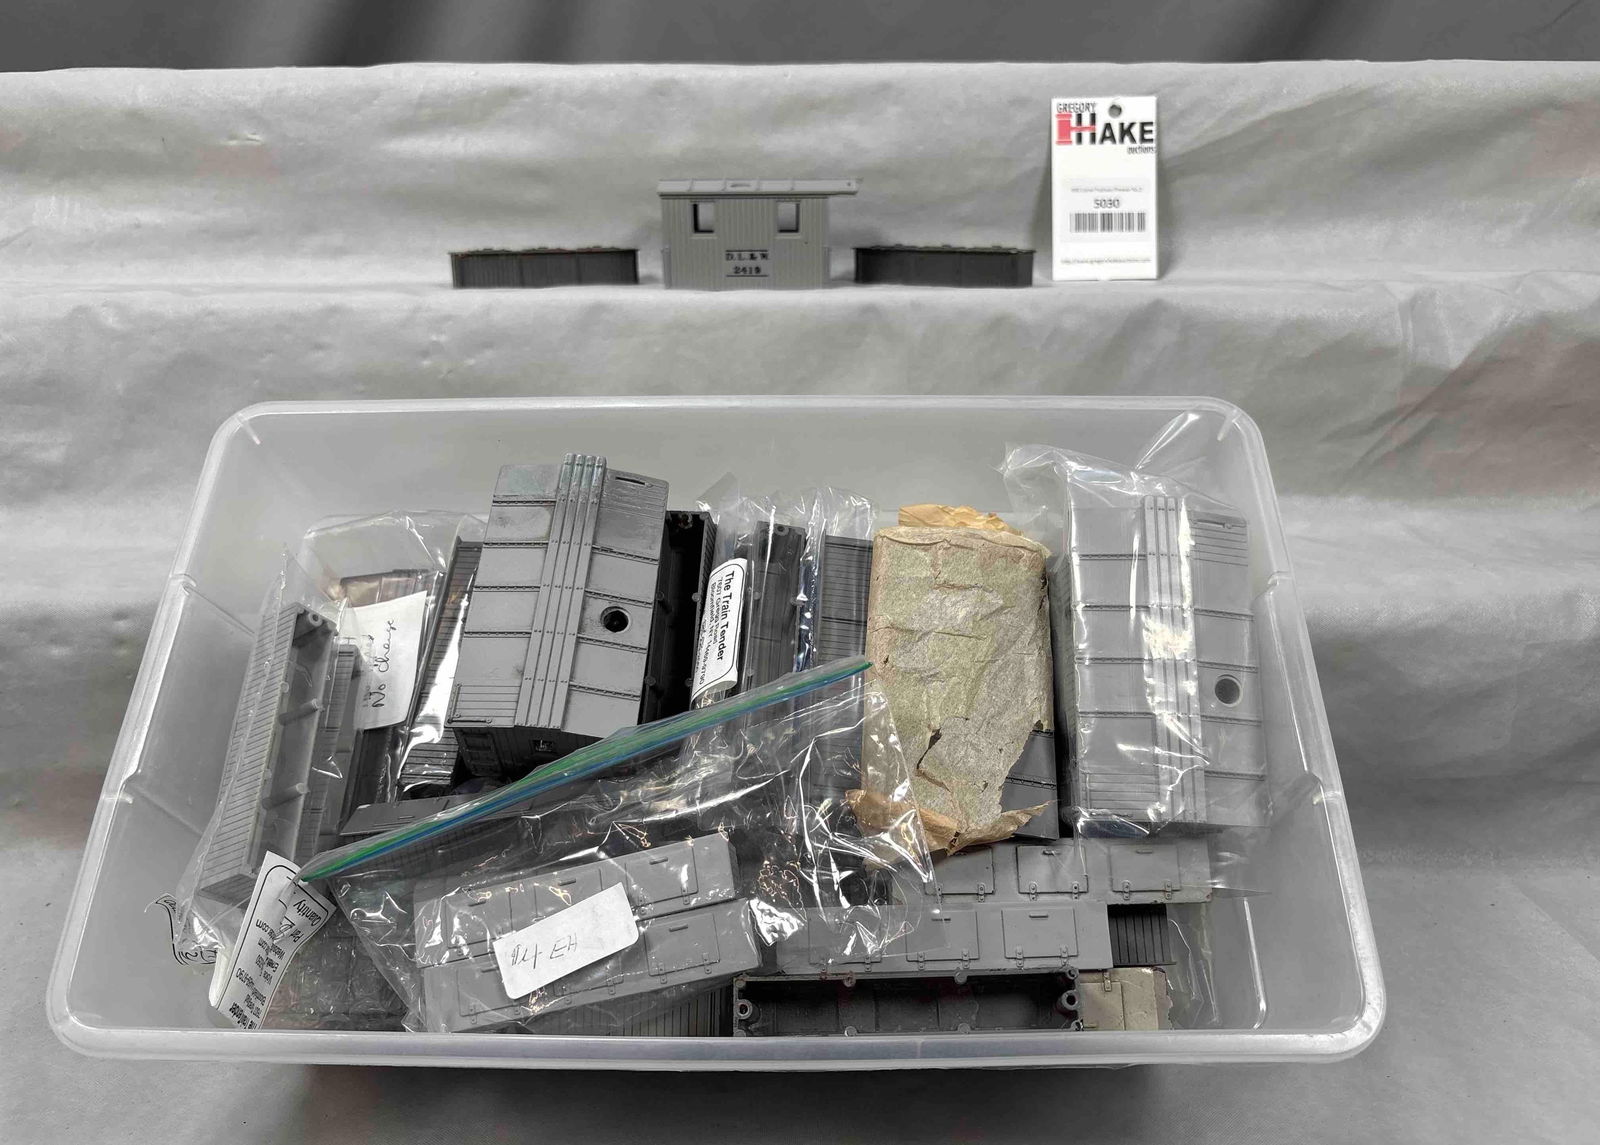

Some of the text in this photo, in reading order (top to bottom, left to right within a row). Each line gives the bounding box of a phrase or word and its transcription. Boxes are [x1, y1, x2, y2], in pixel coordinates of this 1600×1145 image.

[1056, 103, 1096, 113] GREGORY
[1056, 112, 1154, 145] HAKE
[1094, 199, 1120, 209] 5030
[717, 570, 735, 661] The Train Tender
[293, 900, 321, 927] Quantity
